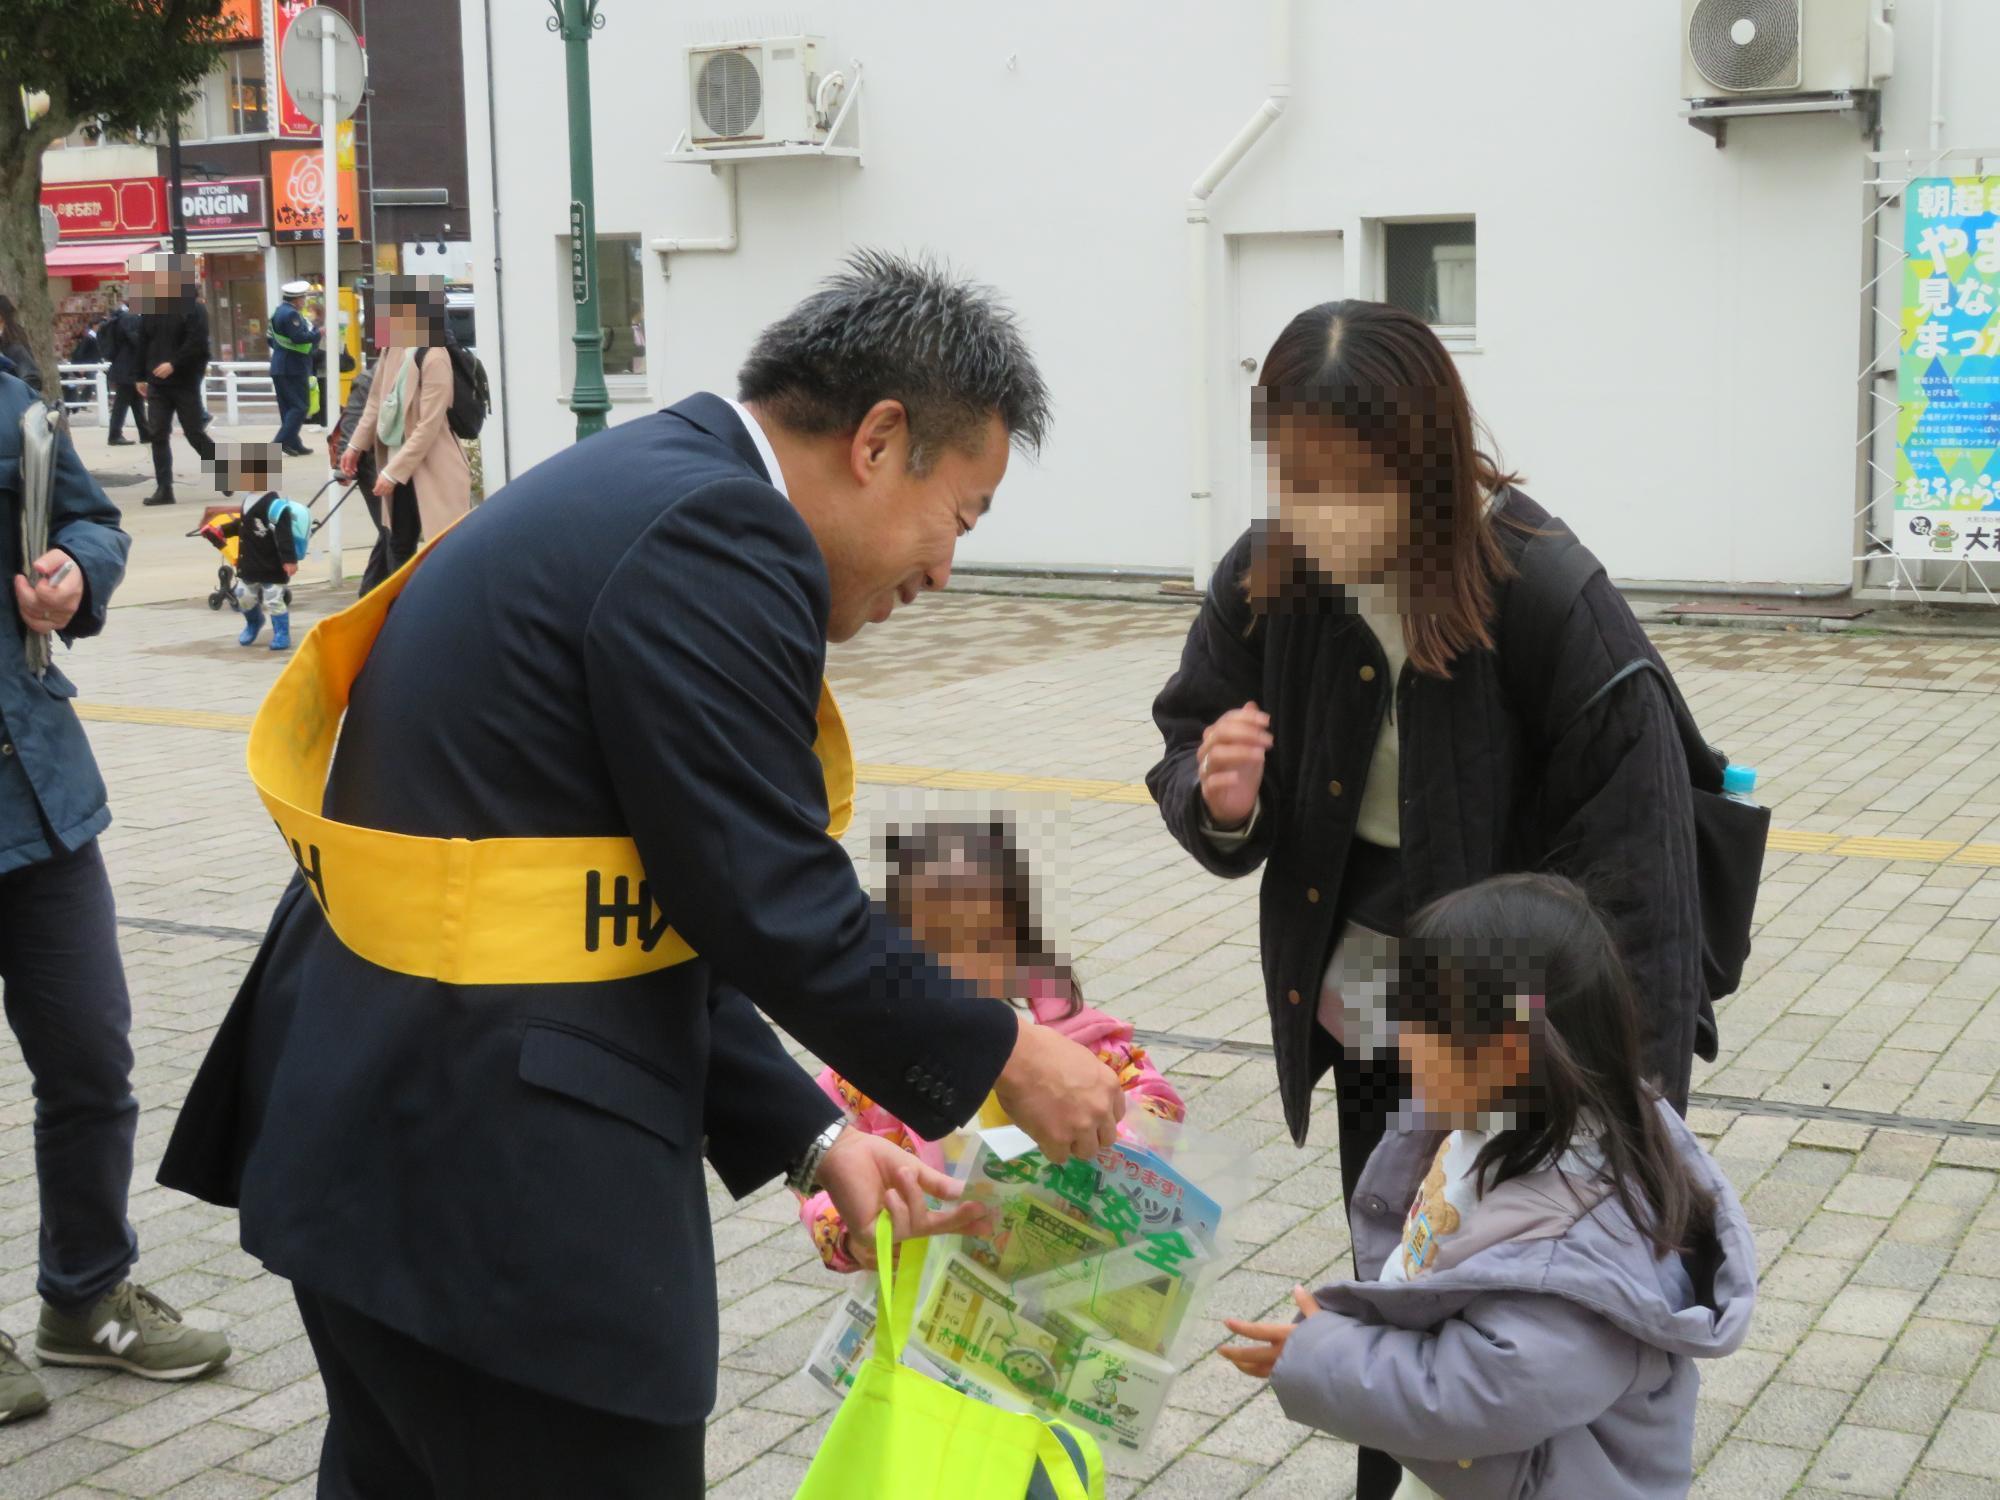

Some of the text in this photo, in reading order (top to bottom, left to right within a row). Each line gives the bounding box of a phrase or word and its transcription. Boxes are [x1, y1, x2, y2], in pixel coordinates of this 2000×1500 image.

[199, 185, 229, 195] KITCHEN
[182, 194, 249, 217] ORIGIN
[1915, 277, 2000, 318] 見な
[1965, 526, 2000, 553] 大
[93, 1320, 138, 1355] N
